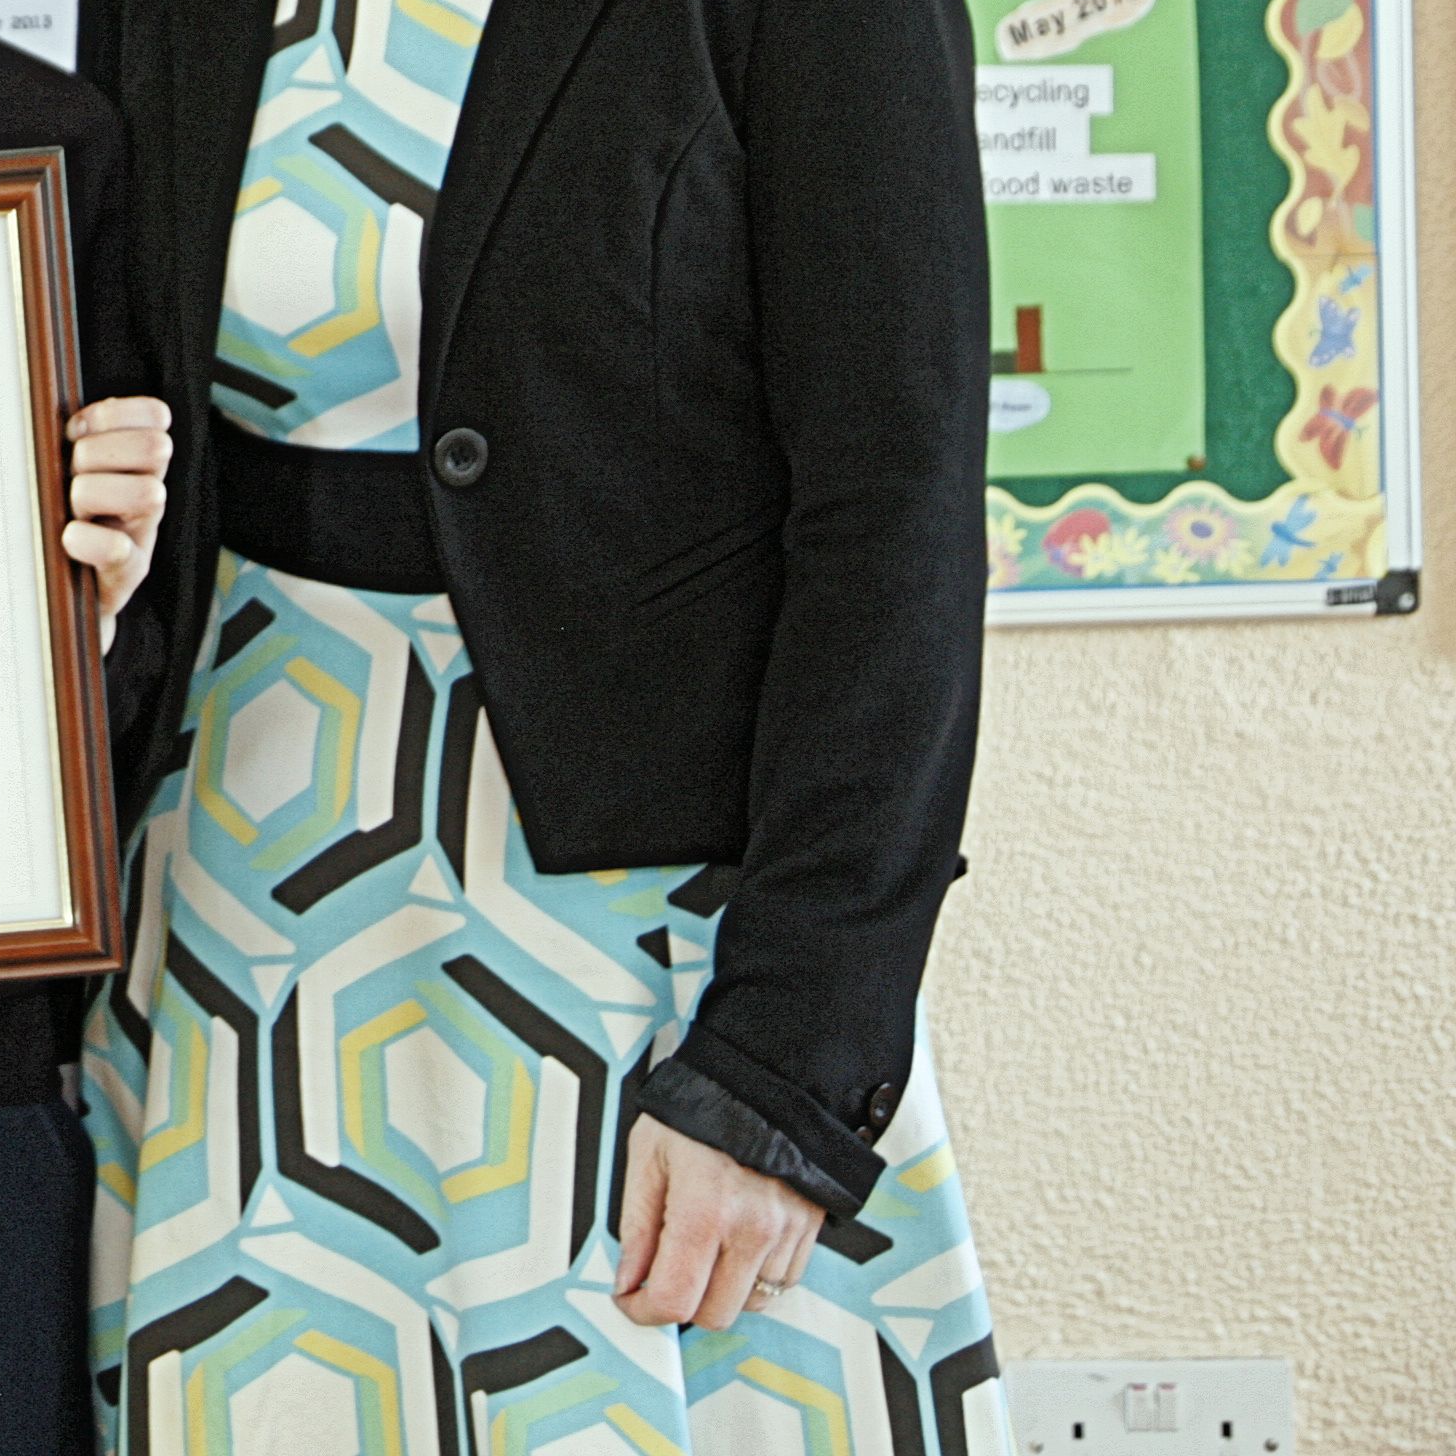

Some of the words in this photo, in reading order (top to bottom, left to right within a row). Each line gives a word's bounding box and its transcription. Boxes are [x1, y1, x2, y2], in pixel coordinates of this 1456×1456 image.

[1008, 9, 1066, 47] May
[975, 79, 1091, 109] ecycling
[978, 126, 1057, 152] andfill
[1049, 171, 1134, 195] waste
